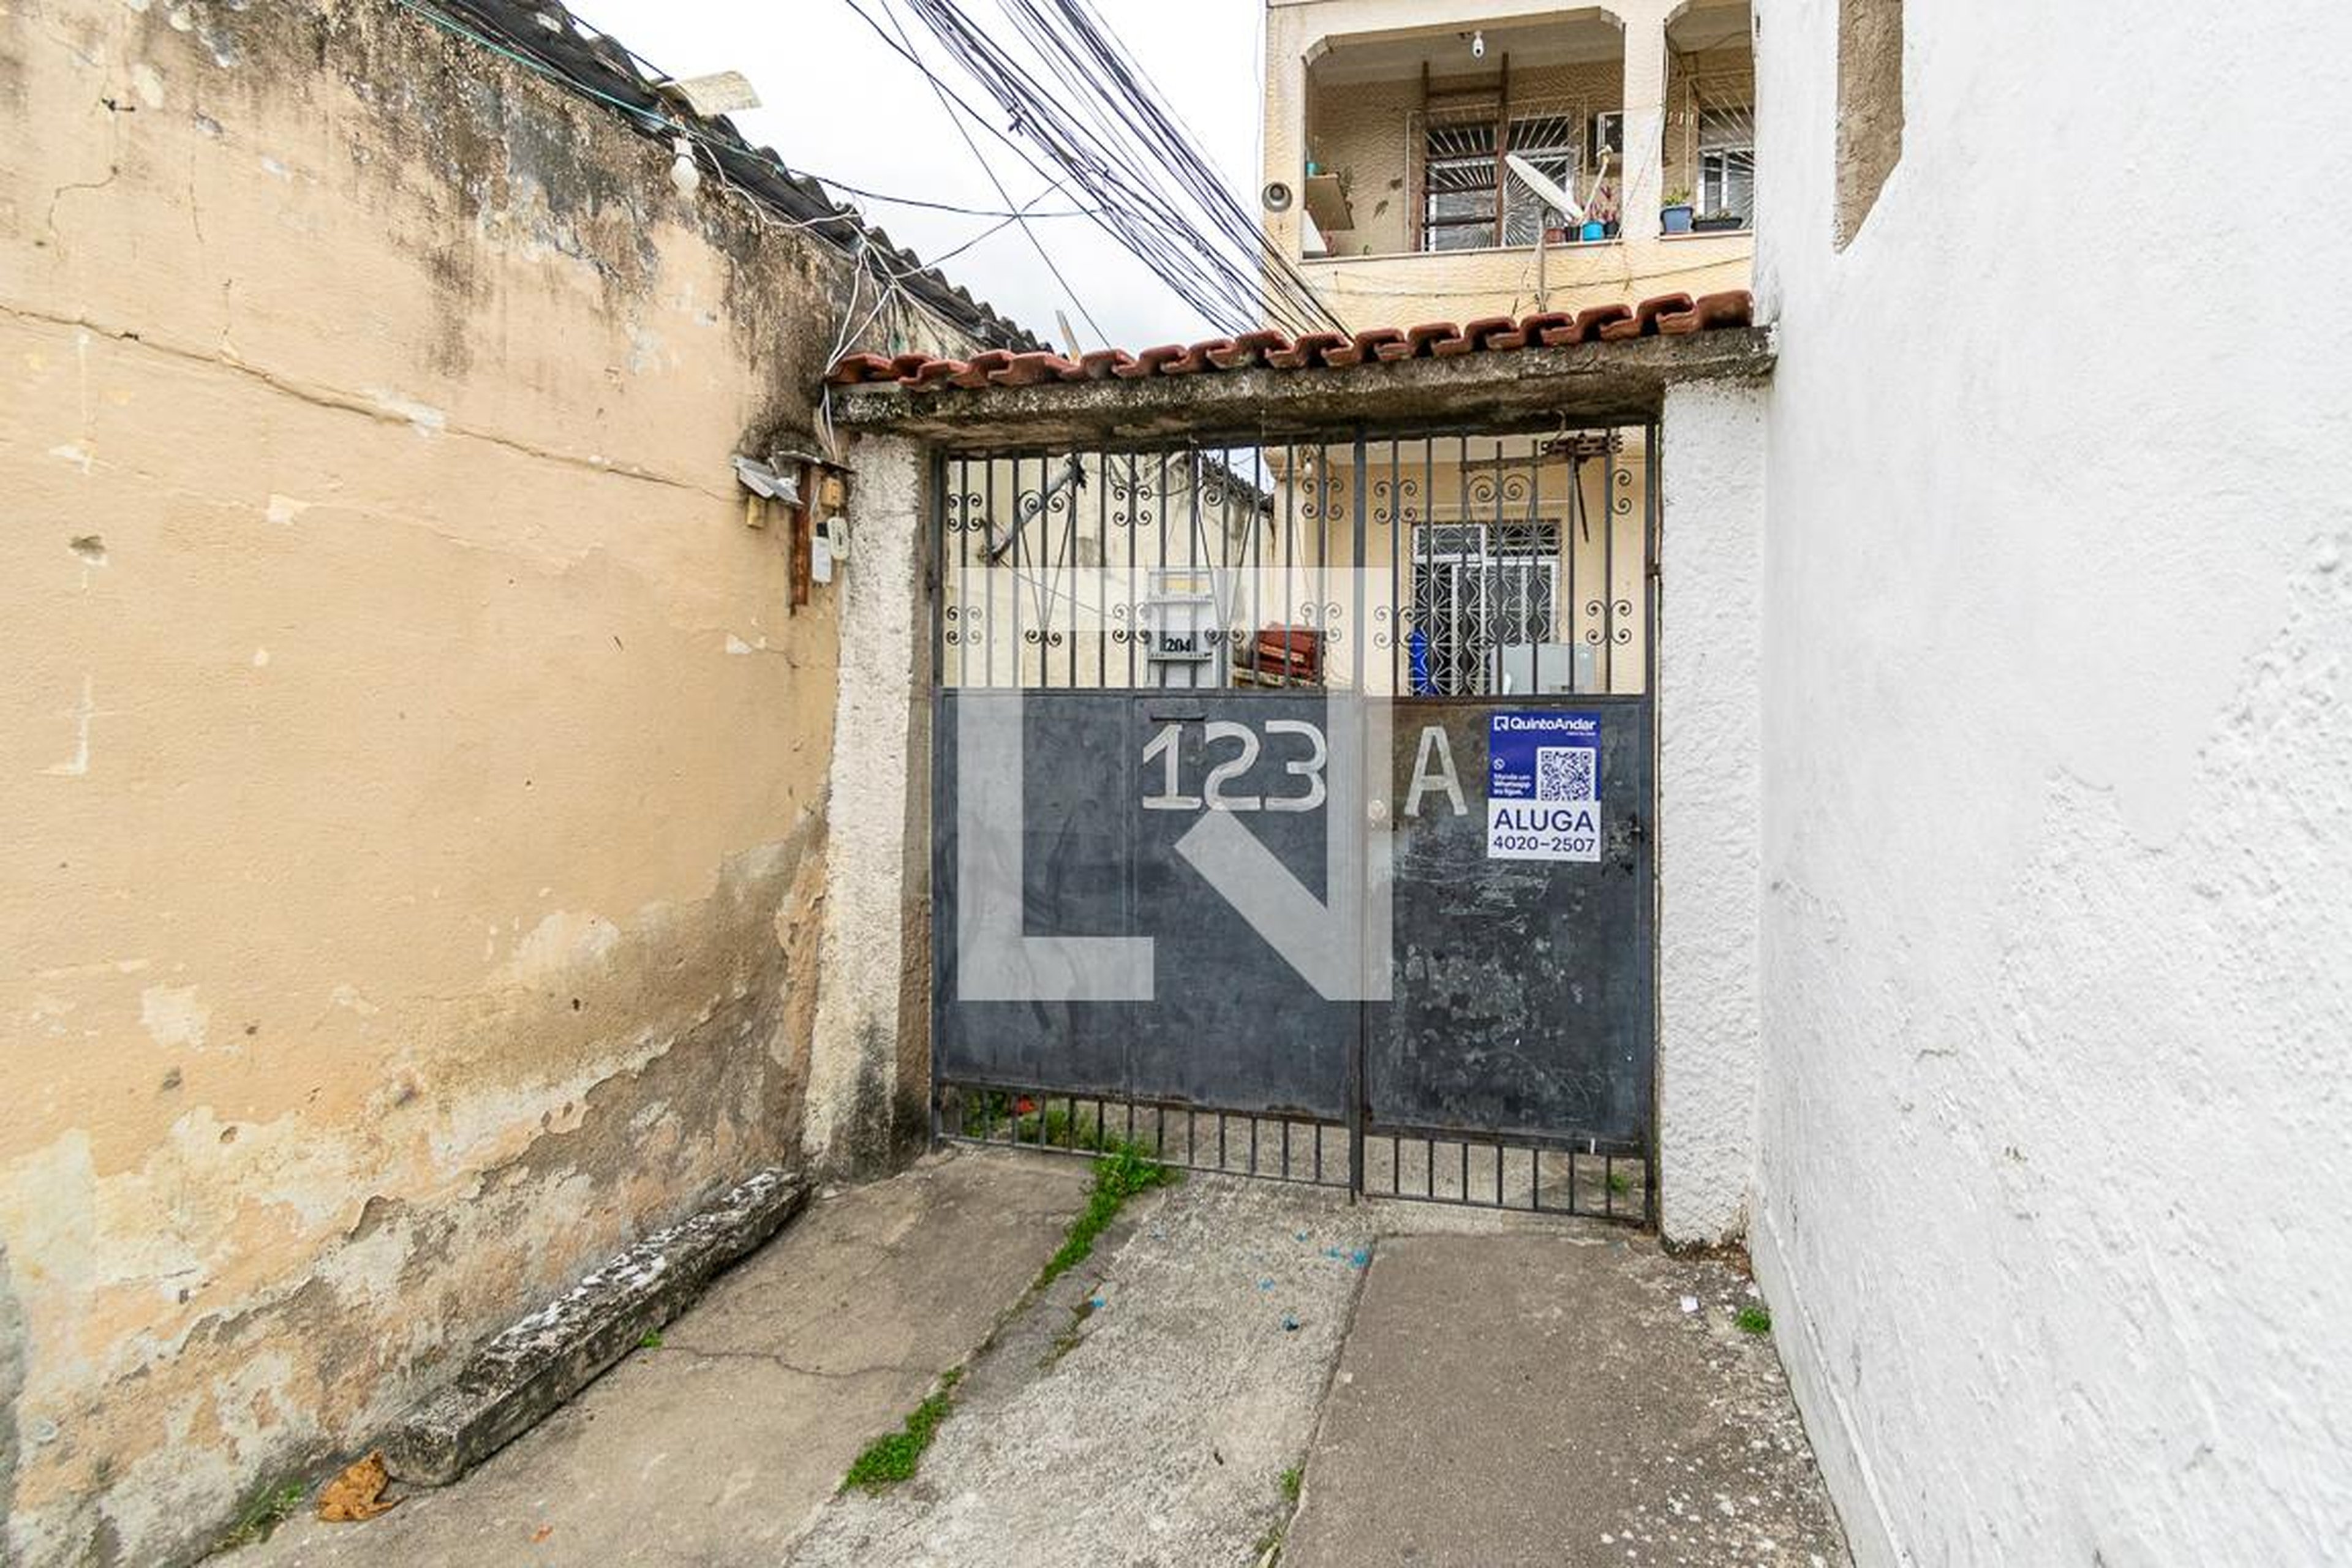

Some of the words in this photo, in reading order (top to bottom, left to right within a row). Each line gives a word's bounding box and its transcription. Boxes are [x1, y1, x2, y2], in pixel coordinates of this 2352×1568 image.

[1510, 717, 1596, 731] QuintoAndar
[1142, 720, 1327, 812] 123
[1404, 726, 1468, 816] A
[1494, 809, 1595, 832] ALUGA
[1493, 836, 1596, 853] 4020-2507
